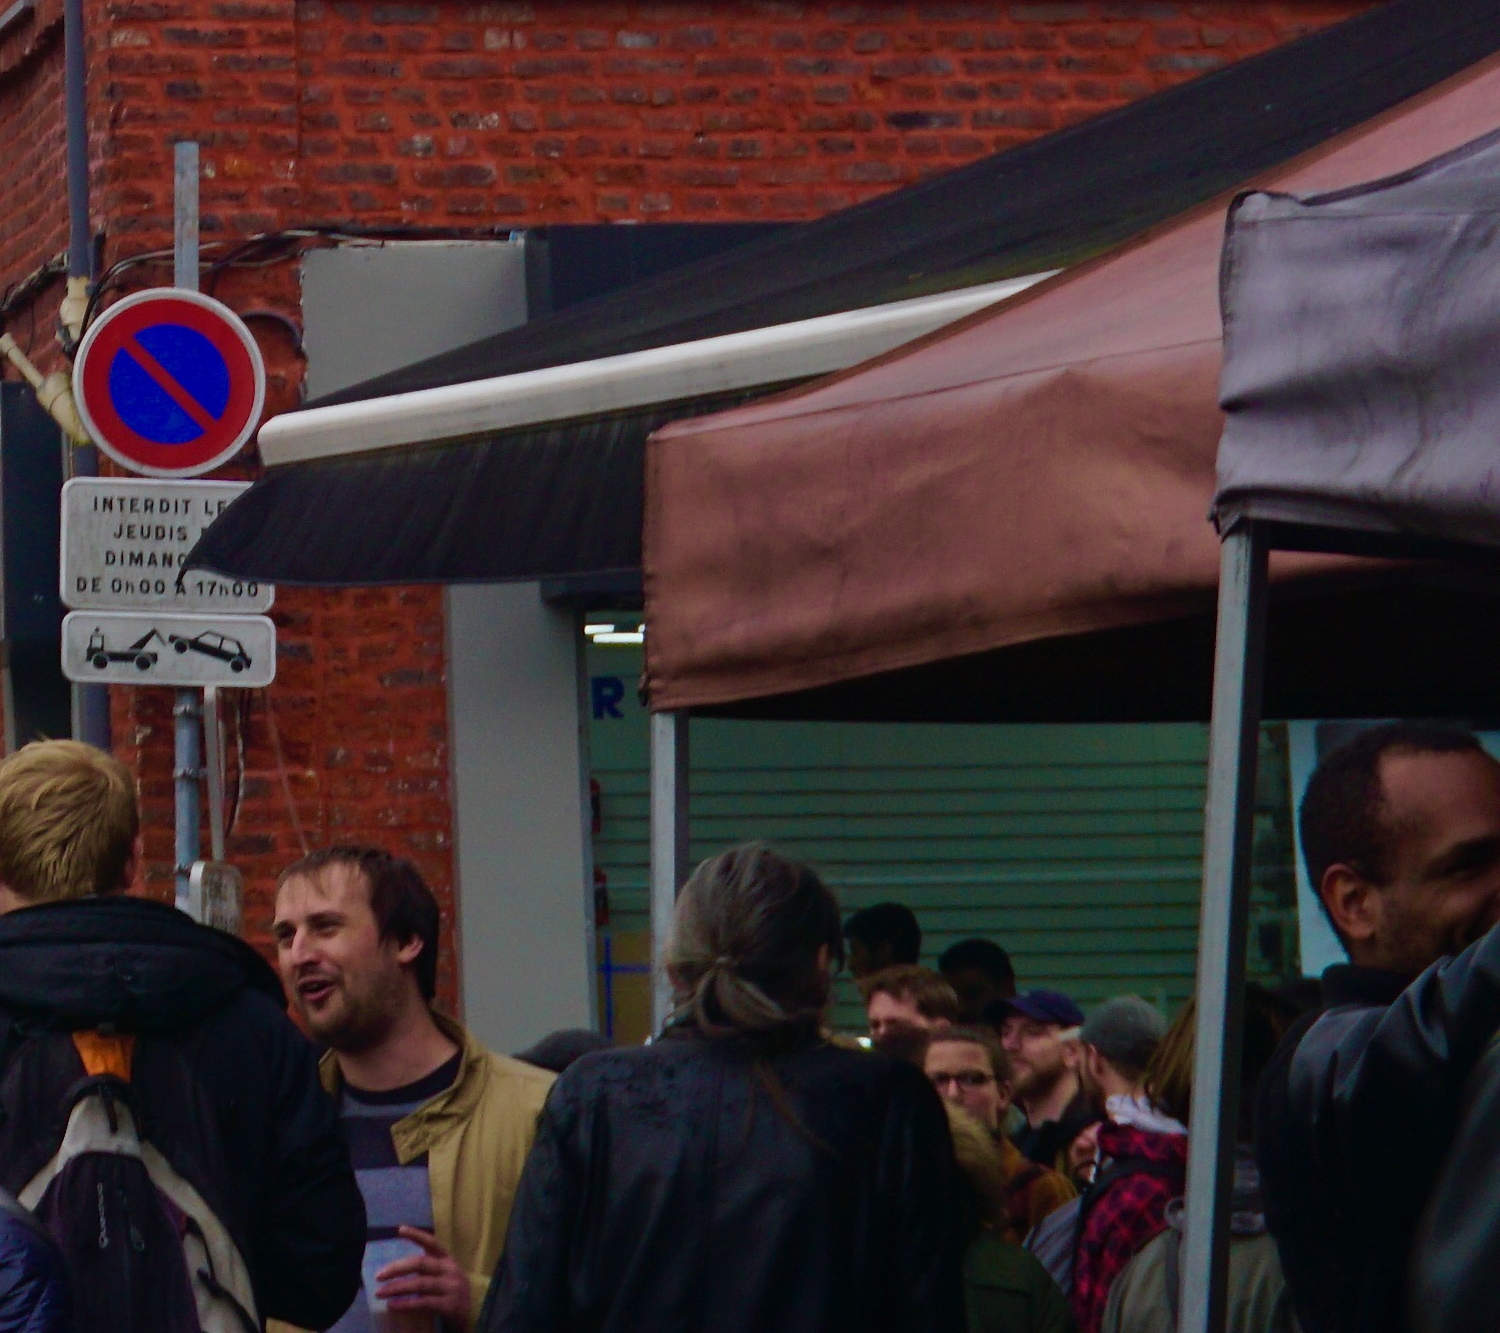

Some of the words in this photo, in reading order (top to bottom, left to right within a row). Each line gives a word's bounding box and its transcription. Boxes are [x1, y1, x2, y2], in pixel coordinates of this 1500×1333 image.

[92, 496, 193, 516] INTERDIT
[203, 498, 229, 517] LE
[113, 523, 188, 541] JEUDIS
[104, 549, 188, 569] DIMANC
[76, 578, 102, 594] DE
[110, 578, 166, 596] 0h00
[196, 581, 259, 600] 17h00
